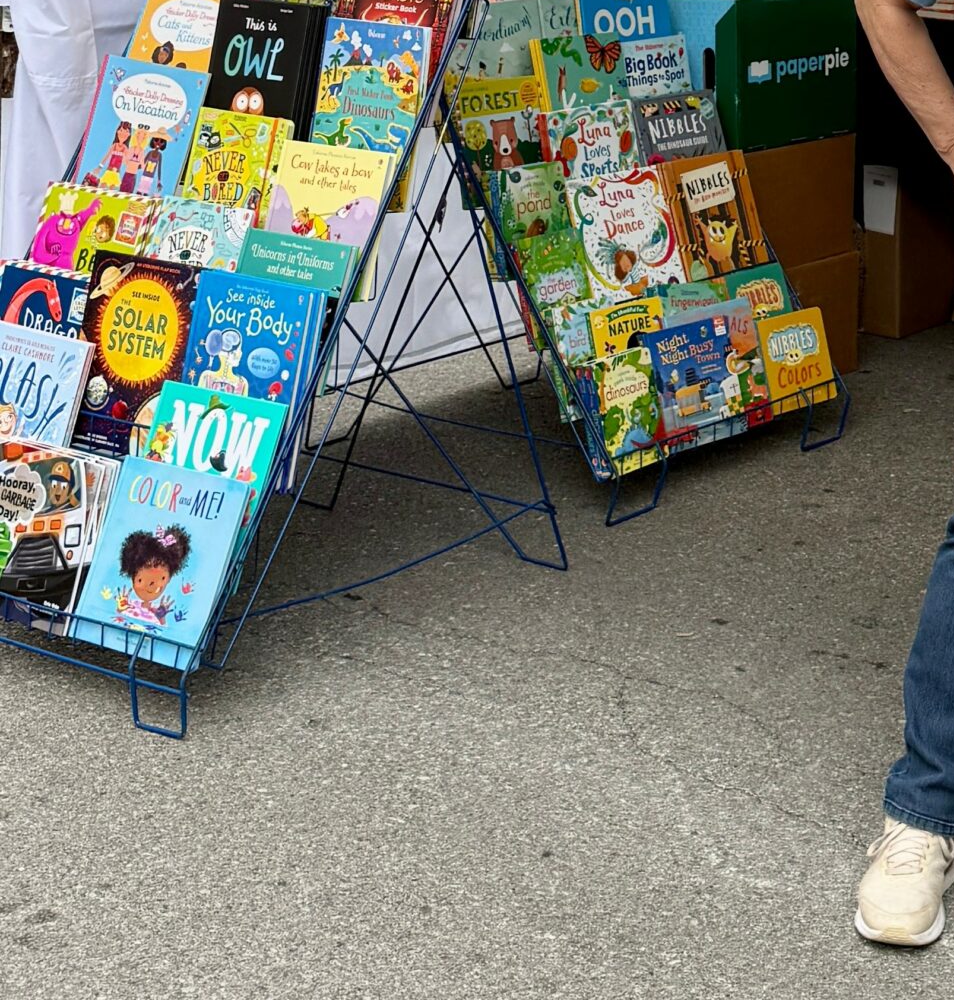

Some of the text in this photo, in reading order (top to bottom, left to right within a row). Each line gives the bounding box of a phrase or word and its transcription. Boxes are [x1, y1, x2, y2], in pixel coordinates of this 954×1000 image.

[374, 2, 417, 13] Sticker Book
[157, 14, 181, 30] Cats
[245, 16, 277, 32] This is
[594, 5, 656, 37] OOH
[175, 30, 211, 46] Kittens
[223, 34, 285, 82] OWL
[624, 50, 678, 77] Big Book
[776, 47, 850, 83] paperpie
[626, 68, 685, 88] Things Spot
[123, 86, 160, 103] Sticker Dolly
[461, 91, 519, 114] FOREST
[115, 94, 179, 121] On Vacation
[341, 96, 396, 121] Dinosaurs
[577, 118, 612, 147] Luna
[647, 112, 707, 145] NIBBLES
[584, 144, 612, 159] Loves
[656, 136, 709, 152] THE DINOSAUR GUIDE
[203, 150, 246, 177] NEVER
[291, 154, 313, 171] Cow
[315, 158, 341, 177] takes
[342, 168, 349, 176] a
[351, 163, 374, 179] bow
[203, 183, 244, 202] BORED
[299, 175, 357, 193] and other tales
[527, 190, 540, 199] the
[599, 181, 636, 209] Luna
[685, 169, 731, 201] NIBBLES
[516, 191, 551, 220] pond
[610, 207, 635, 222] Loves
[604, 218, 646, 240] Dance
[168, 230, 209, 253] NEVER
[252, 243, 286, 262] Unicorns
[287, 254, 297, 264] in
[296, 252, 335, 271] Uniforms
[267, 263, 313, 280] and other tales
[132, 290, 160, 302] SEE INSIDE
[226, 288, 245, 304] See
[247, 293, 276, 310] inside
[539, 275, 578, 300] garden
[120, 298, 132, 306] THE
[112, 305, 168, 336] SOLAR
[206, 295, 293, 346] Your Body
[608, 315, 652, 337] NATURE
[2, 342, 23, 355] CLAIRE
[24, 347, 55, 364] CASHMORE
[107, 329, 167, 361] SYSTEM
[568, 336, 587, 349] bird
[660, 339, 715, 366] Night Busy
[771, 327, 814, 358] NIBBLES
[695, 352, 721, 364] Town
[605, 379, 648, 402] dinosaurs
[163, 399, 271, 479] NOW
[0, 477, 36, 494] Hooray,
[1, 489, 37, 512] GARBAGE
[128, 475, 225, 521] COLOR and ME!
[0, 505, 19, 522] Day!
